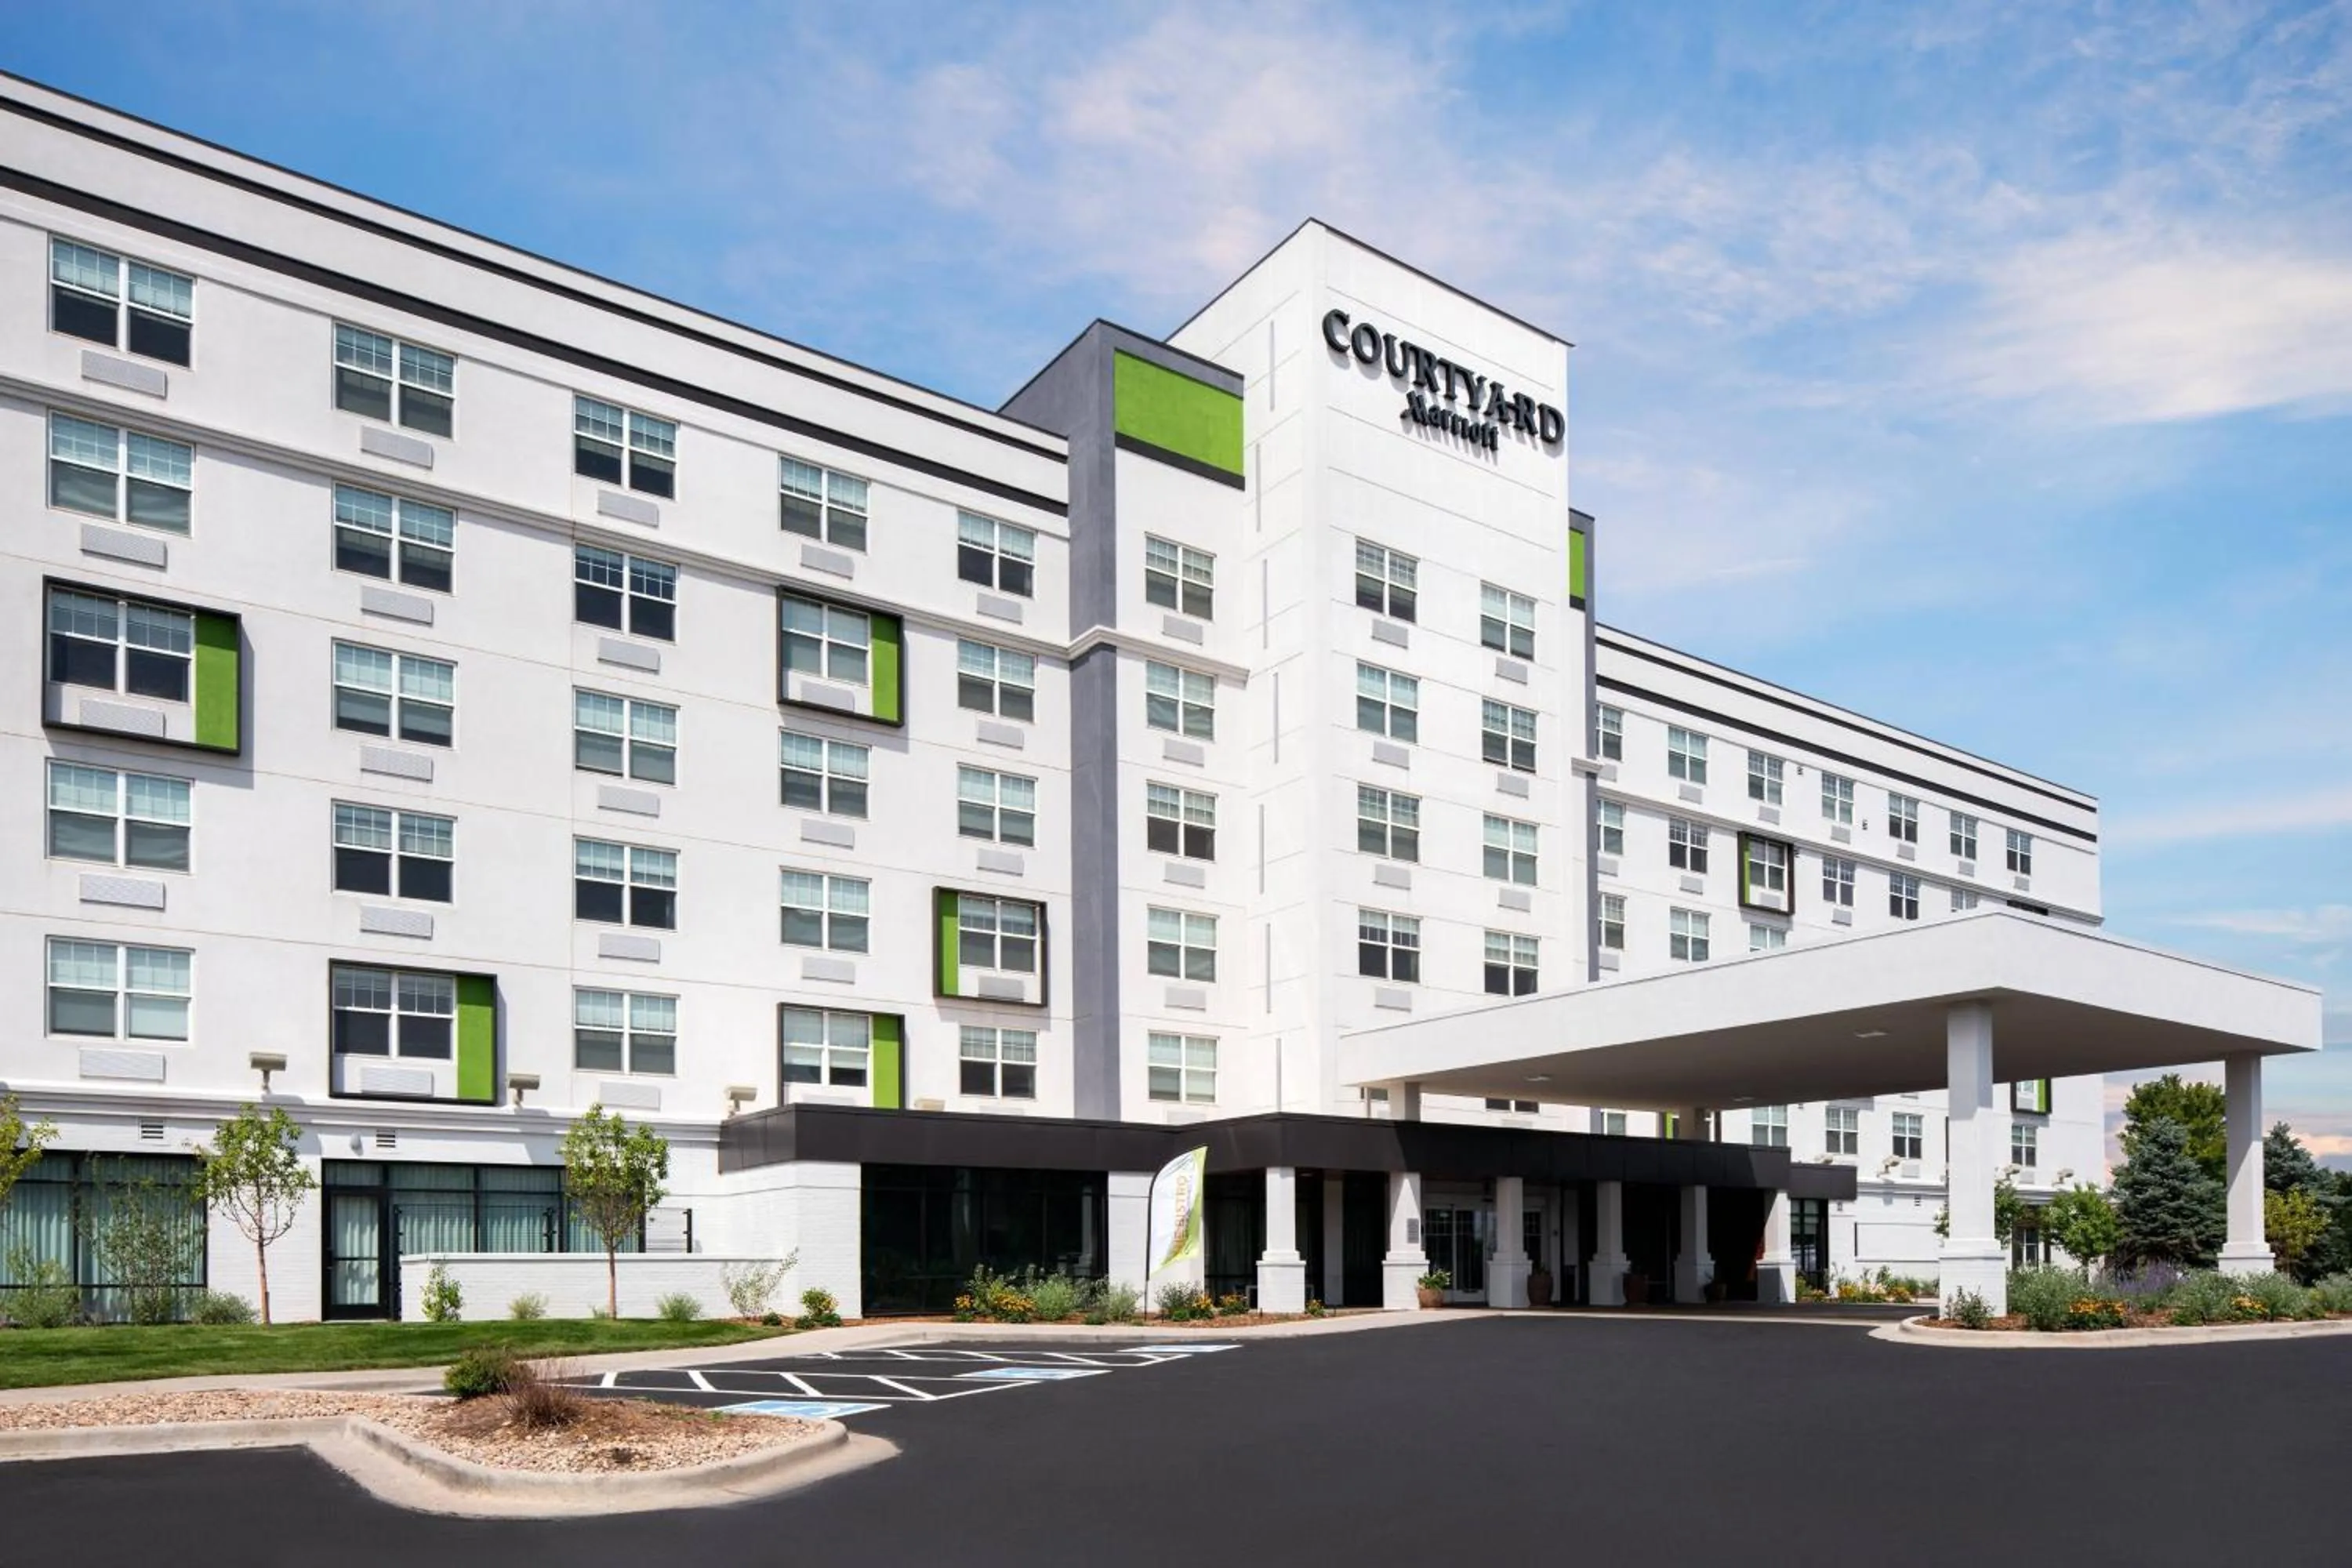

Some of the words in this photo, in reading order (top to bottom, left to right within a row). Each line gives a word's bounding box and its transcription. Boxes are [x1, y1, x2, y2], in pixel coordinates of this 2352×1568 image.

[1322, 309, 1566, 445] COURTYARD
[1399, 390, 1498, 452] Marriott
[1174, 1175, 1188, 1228] BISTRO
